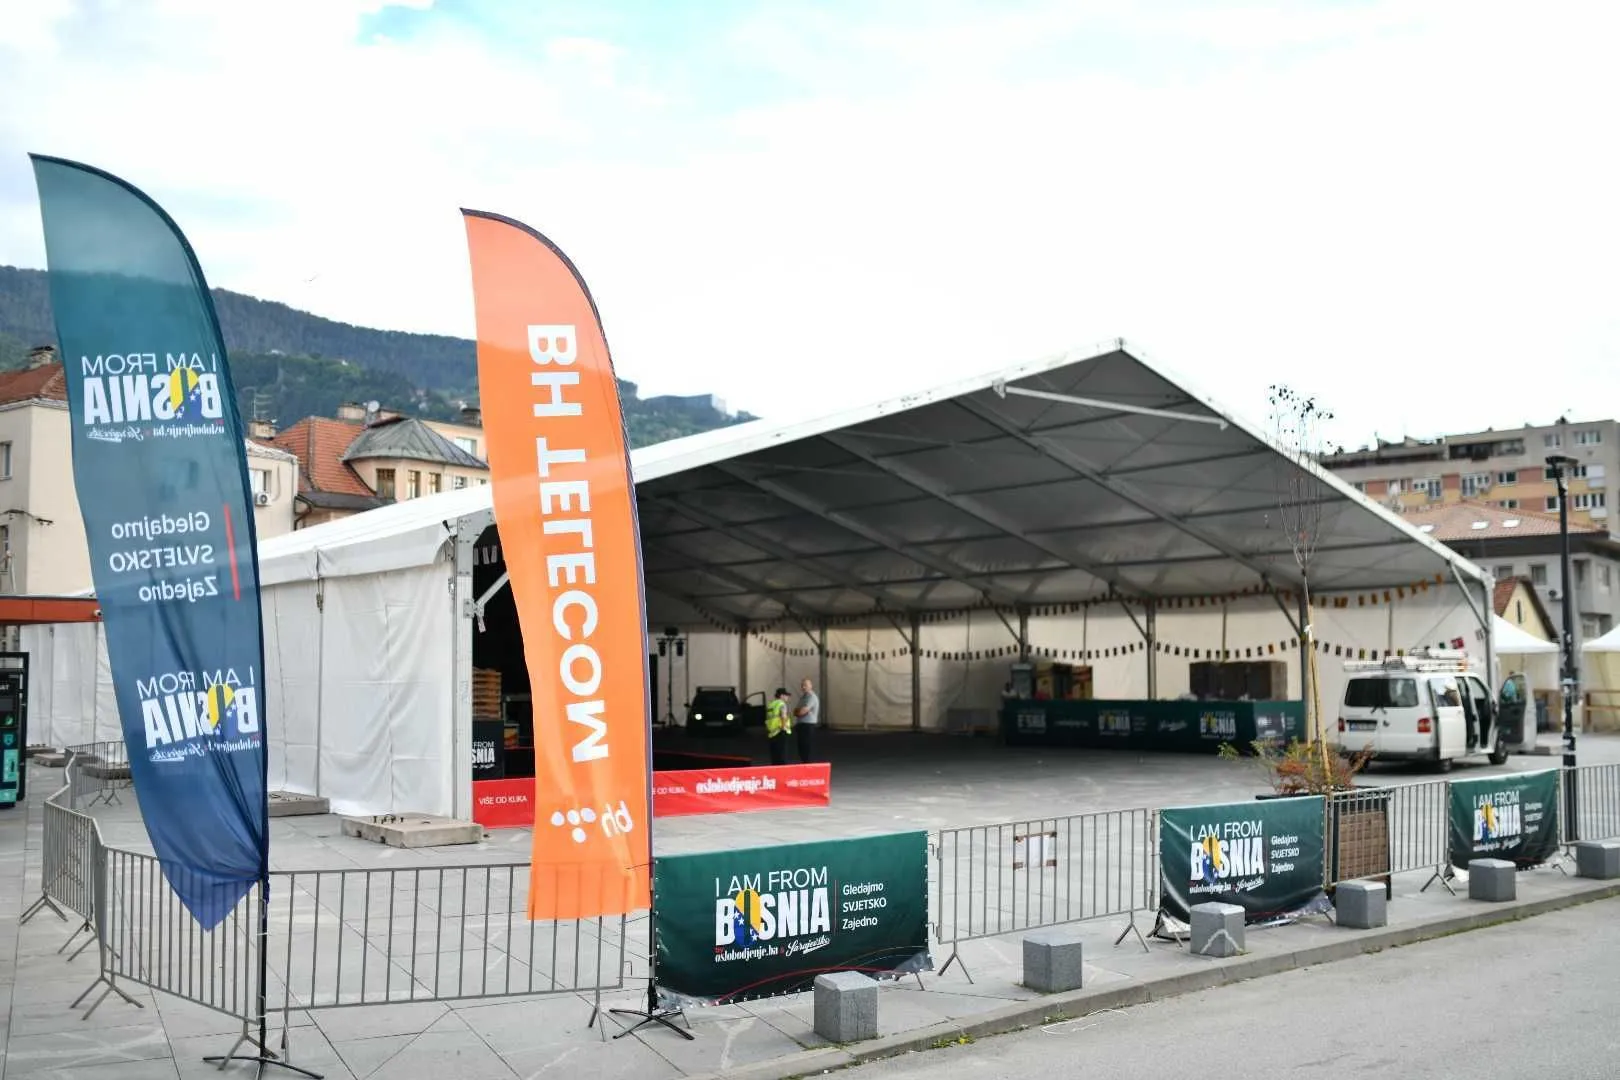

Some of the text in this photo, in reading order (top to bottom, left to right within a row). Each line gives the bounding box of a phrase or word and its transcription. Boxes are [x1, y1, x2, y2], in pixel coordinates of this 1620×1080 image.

[471, 748, 496, 764] SNIA
[495, 796, 507, 804] OD
[1495, 790, 1520, 805] FROM
[1198, 823, 1220, 840] AM
[1224, 820, 1263, 838] FROM
[1271, 835, 1298, 847] Gledajmo
[1190, 835, 1265, 884] BOSNIA
[1271, 848, 1299, 859] SVJETSKO
[1271, 863, 1295, 874] Zajedno
[715, 866, 828, 897] I AM FROM
[842, 881, 884, 896] Gledajmo
[842, 897, 887, 913] SVJETSKO
[715, 887, 831, 948] BOSNIA
[842, 916, 878, 930] Zajedno
[715, 944, 778, 962] oslobodjenje.ba
